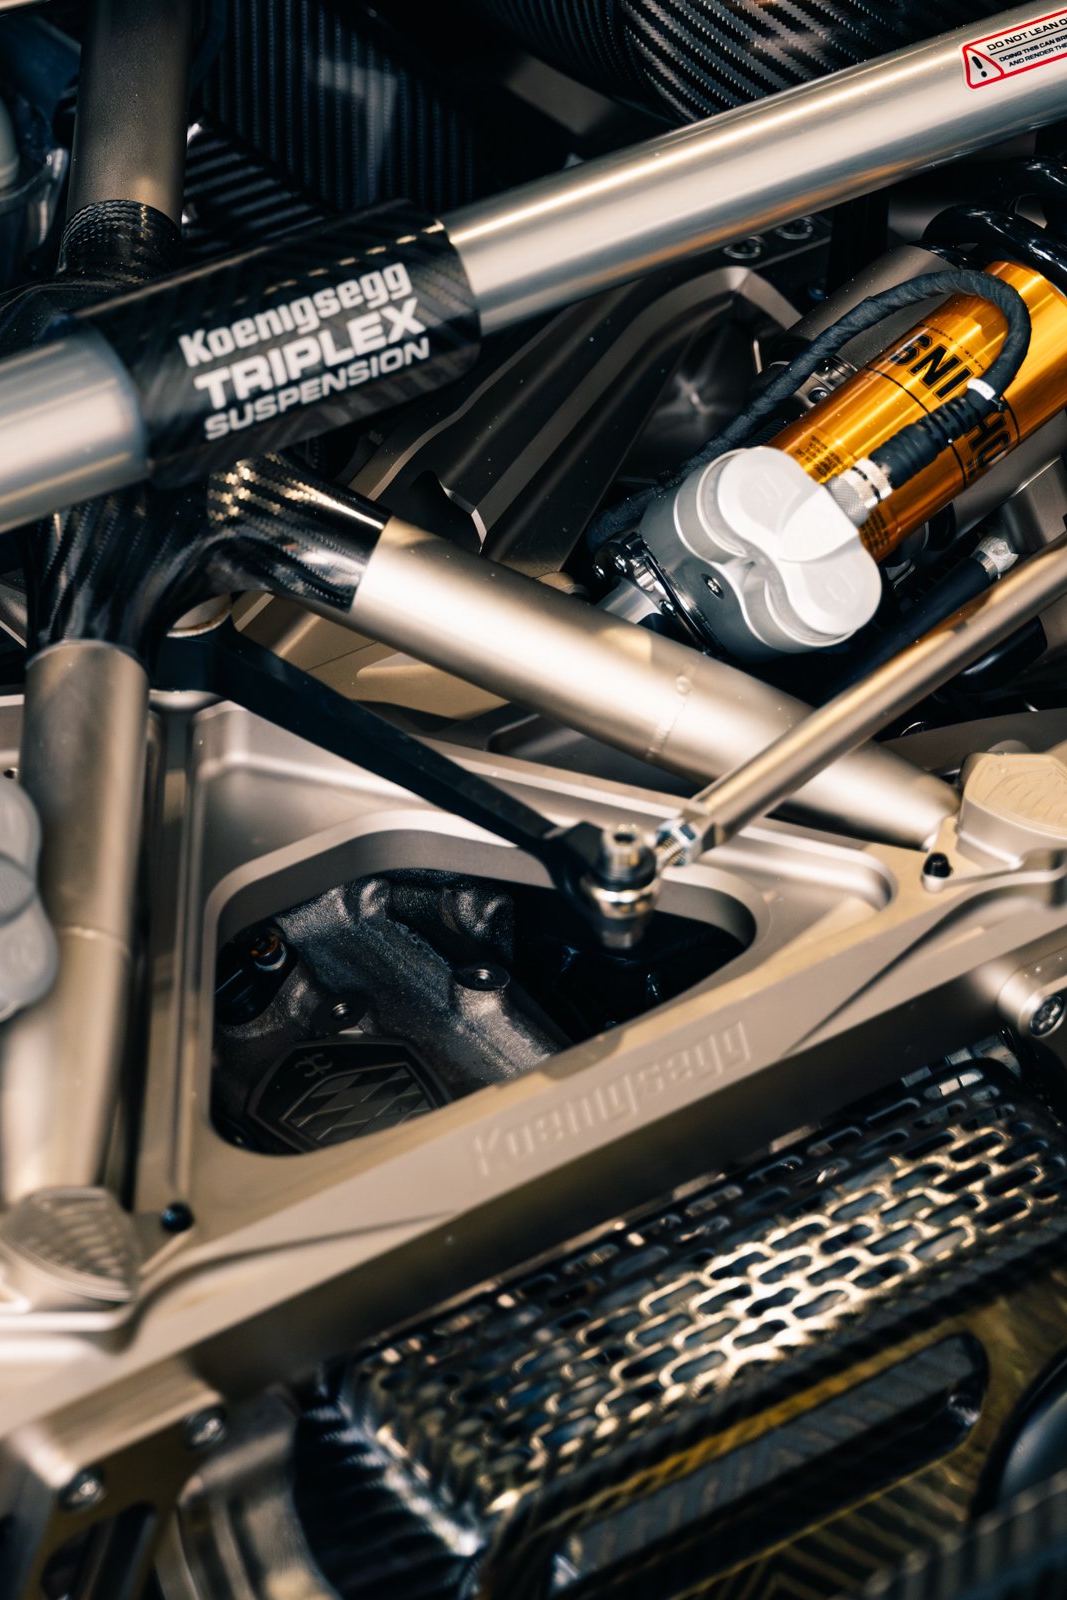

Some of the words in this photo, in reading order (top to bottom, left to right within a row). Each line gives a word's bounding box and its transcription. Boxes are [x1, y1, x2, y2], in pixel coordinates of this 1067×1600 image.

[987, 41, 1005, 51] DO
[1004, 32, 1028, 45] NOT
[1028, 22, 1059, 37] LEAN
[999, 50, 1023, 62] DOING
[1022, 45, 1040, 54] THIS
[1039, 39, 1055, 48] CAN
[1009, 57, 1025, 67] AND
[1024, 47, 1055, 62] RENDER
[177, 261, 413, 368] Koenigsegg
[193, 297, 427, 411] TRIPLEX
[204, 337, 430, 441] SUSPENSION
